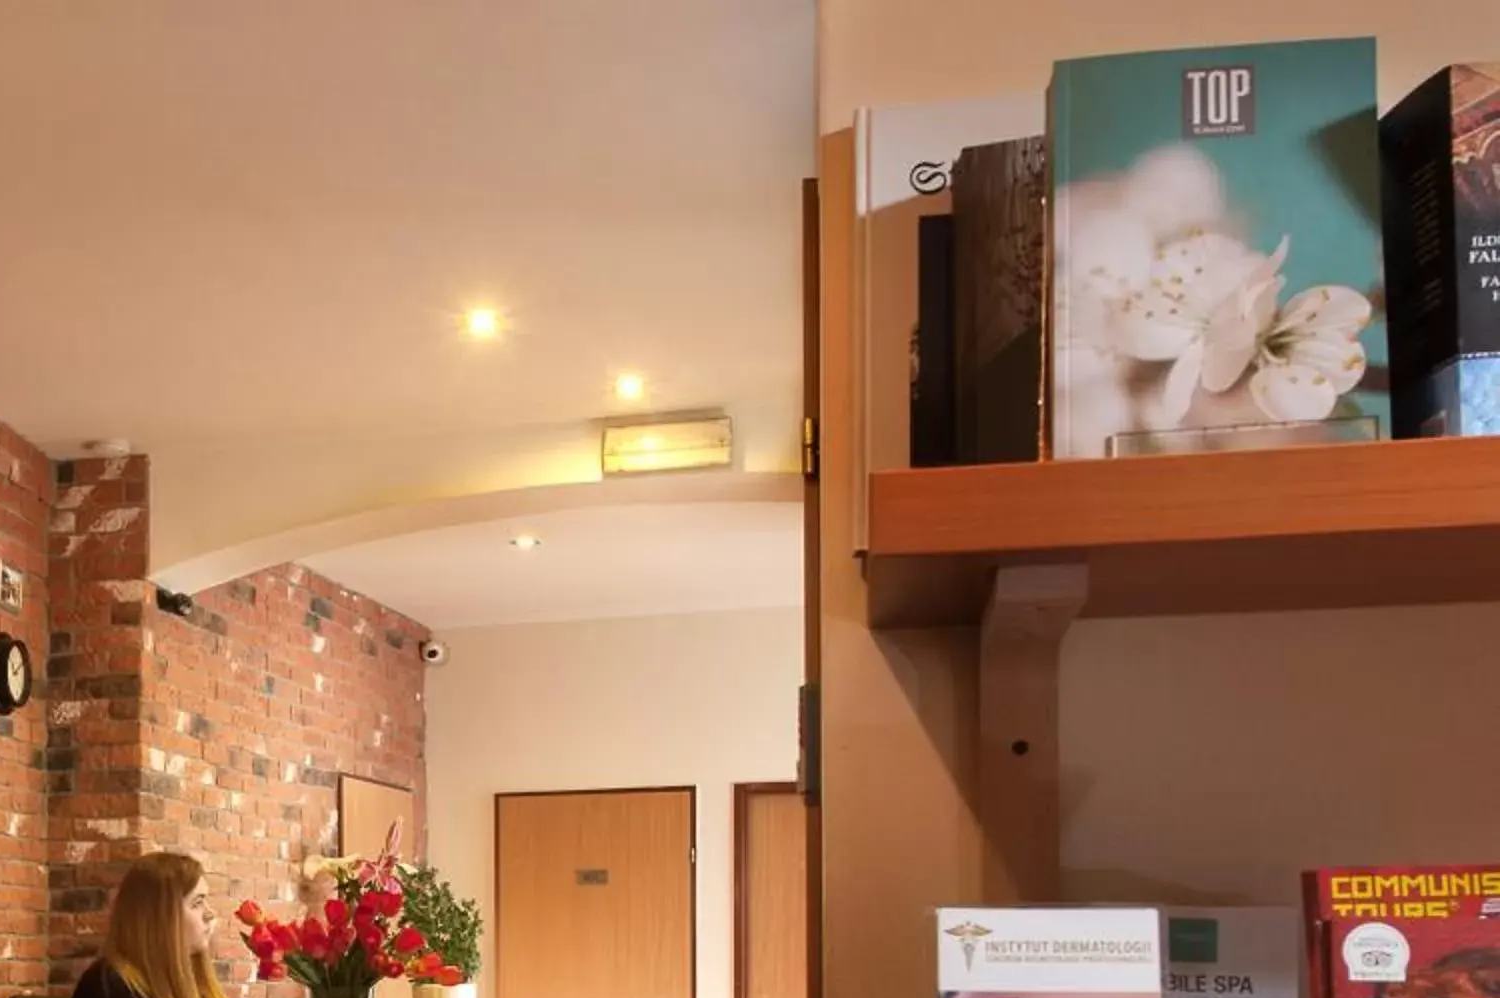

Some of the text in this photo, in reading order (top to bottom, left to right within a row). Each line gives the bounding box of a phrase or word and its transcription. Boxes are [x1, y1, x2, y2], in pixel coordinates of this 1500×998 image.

[1186, 69, 1250, 125] TOP
[985, 941, 1049, 954] INSTYTUT
[1213, 975, 1253, 995] SPA
